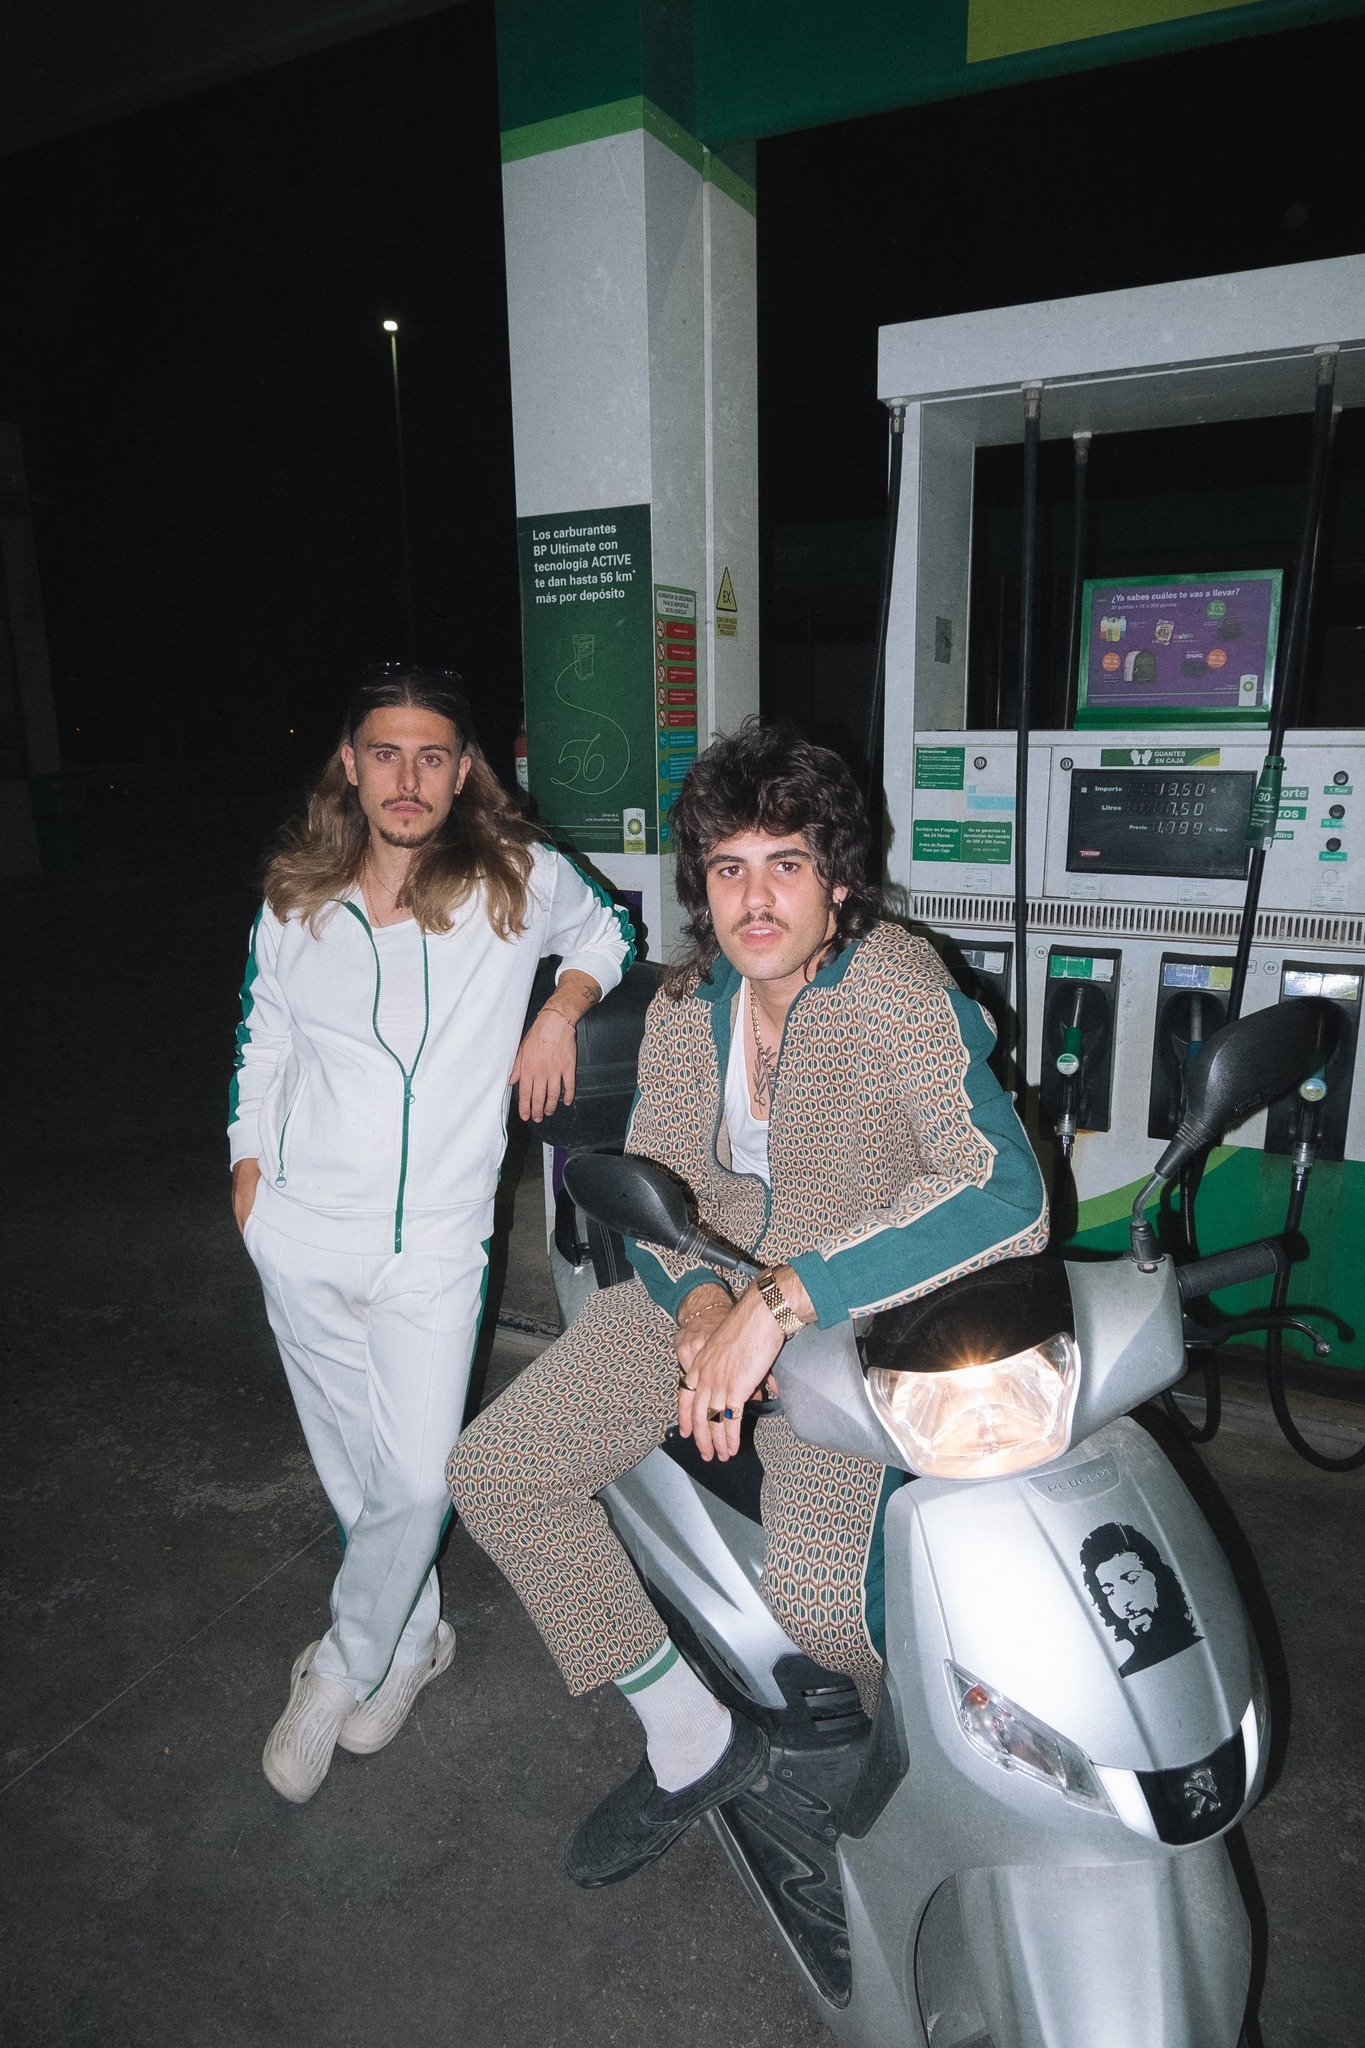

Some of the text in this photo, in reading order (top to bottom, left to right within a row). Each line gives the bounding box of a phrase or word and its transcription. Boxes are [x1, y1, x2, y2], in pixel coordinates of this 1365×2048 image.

[532, 524, 617, 540] Los carburantes
[534, 541, 618, 556] BP Ultimate con
[534, 554, 632, 572] tecnología ACTIVE
[535, 578, 545, 588] te
[548, 576, 566, 588] dan
[570, 574, 598, 586] hasta
[600, 572, 614, 583] 56
[536, 588, 625, 604] más por depósito
[723, 590, 731, 604] EX
[1111, 594, 1125, 604] ¿Ya
[1151, 592, 1178, 600] cuáles
[1212, 588, 1240, 597] llevar?
[1281, 788, 1307, 798] orte
[1278, 808, 1299, 818] ros
[1274, 831, 1292, 839] /litro
[1048, 1468, 1112, 1492] PEUGEOT
